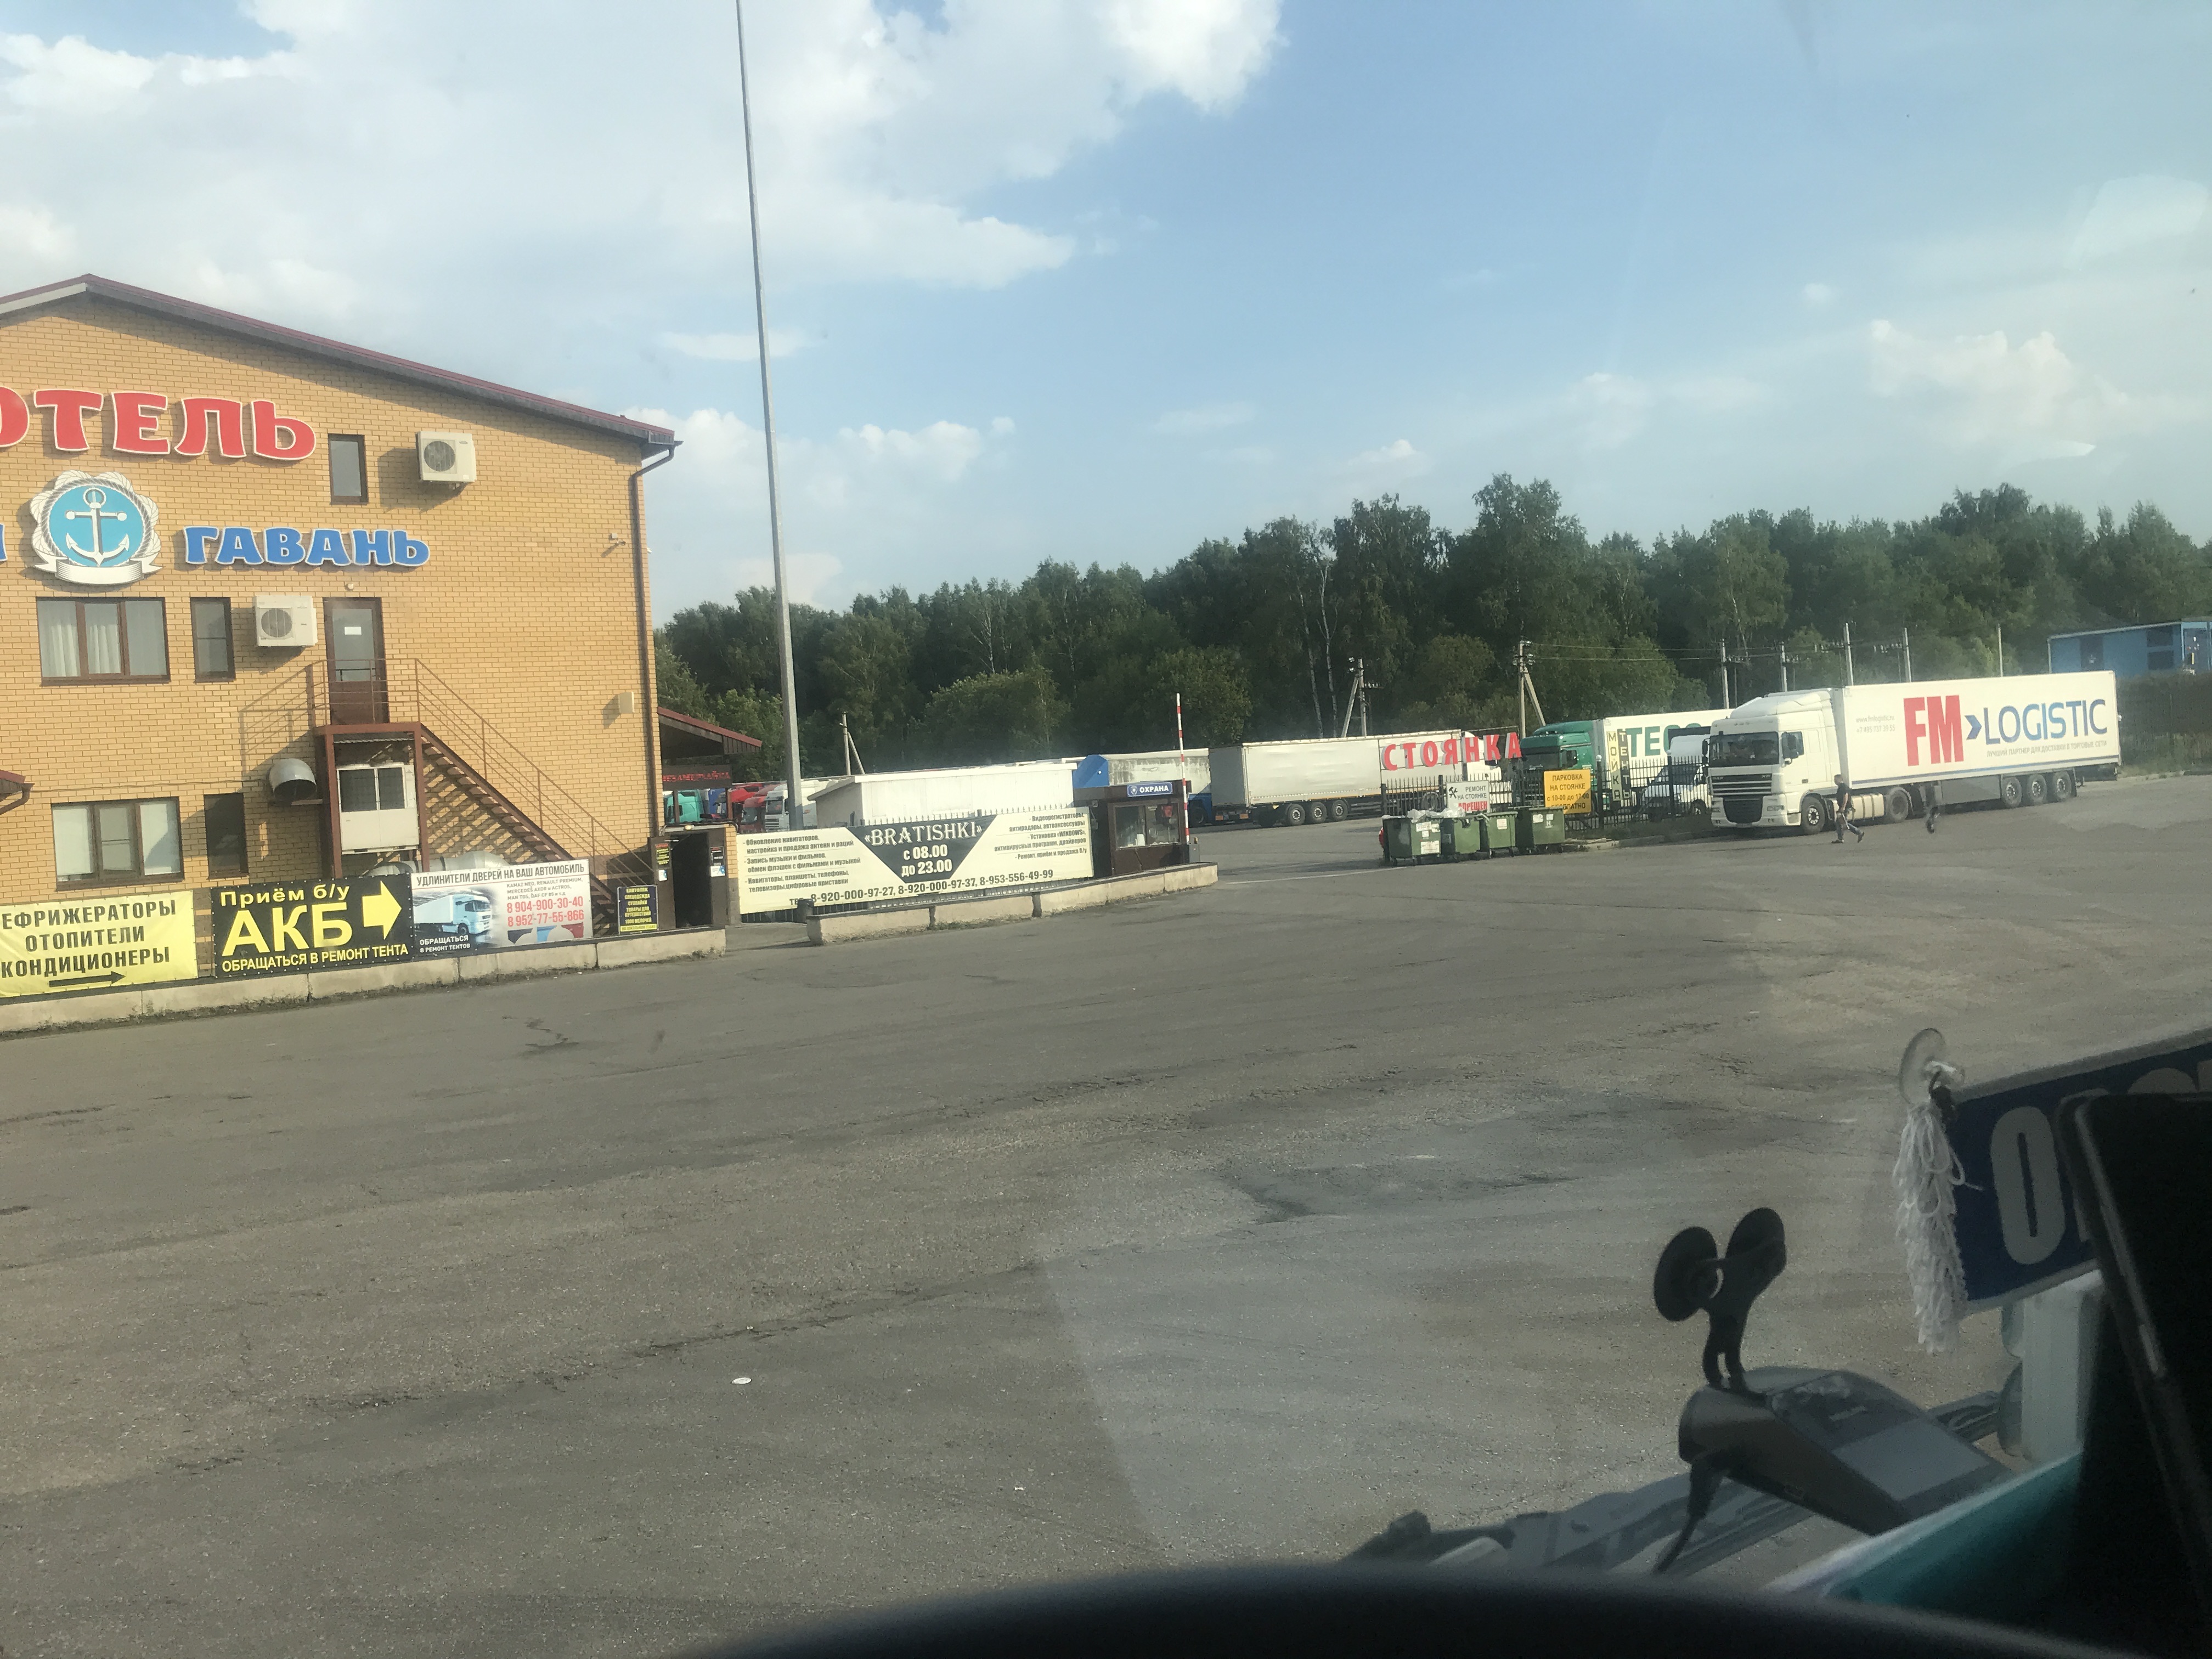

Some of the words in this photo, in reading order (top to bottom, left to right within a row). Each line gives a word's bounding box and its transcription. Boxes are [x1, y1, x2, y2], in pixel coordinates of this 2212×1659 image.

[183, 527, 431, 566] ГАВАНЬ
[1904, 695, 1964, 766] FM
[1983, 699, 2107, 745] LOGISTIC
[1381, 732, 1522, 771] СТОЯНКА
[1608, 732, 1620, 799] МОЙКА
[1619, 732, 1631, 798] ТЕНТЫ
[1139, 785, 1169, 793] ОХРАНА
[865, 821, 983, 846] «BRATISHKI»
[1043, 820, 1085, 829] автоаксессуары
[746, 837, 781, 846] Обновление
[747, 846, 777, 854] настройка
[783, 844, 809, 852] продажа
[836, 840, 854, 848] раций
[994, 843, 1031, 851] антивирусных
[1059, 837, 1086, 846] драйверов
[747, 856, 768, 865] Запись
[769, 855, 792, 863] музыки
[904, 850, 910, 860] с
[912, 844, 948, 860] 08.00
[1058, 848, 1079, 856] продажа
[748, 865, 766, 873] обмен
[768, 864, 792, 872] флэшек
[797, 860, 829, 869] фильмами
[834, 857, 861, 866] музыкой
[901, 865, 915, 877] до
[917, 859, 952, 874] 23.00
[417, 871, 470, 887] УДЛИНИТЕЛИ
[472, 868, 502, 882] ДВЕРЕЙ
[504, 869, 514, 879] НА
[516, 867, 533, 878] ВАШ
[535, 864, 585, 876] АВТОМОБИЛЬ
[818, 878, 848, 887] приставки
[898, 878, 978, 895] 8-920-000-97-37,
[980, 870, 1053, 885] 8-953-556-49-99
[221, 888, 304, 908] Приём
[313, 883, 349, 900] б/у
[507, 902, 513, 913] 8
[515, 896, 583, 913] 904-900-30-40
[2, 900, 176, 929] ЕФРИЖЕРАТОРЫ
[507, 916, 514, 927] 8
[516, 909, 584, 927] 952-77-55-866
[25, 926, 145, 952] ОТОПИТЕЛИ
[222, 902, 352, 956] АКБ
[420, 935, 469, 945] ОБРАЩАТЬСЯ
[1, 946, 170, 978] КОНДИЦИОНЕРЫ
[222, 953, 307, 972] ОБРАЩАТЬСЯ
[311, 953, 318, 964] В
[321, 947, 369, 963] РЕМОНТ
[372, 944, 408, 957] ТЕНТА
